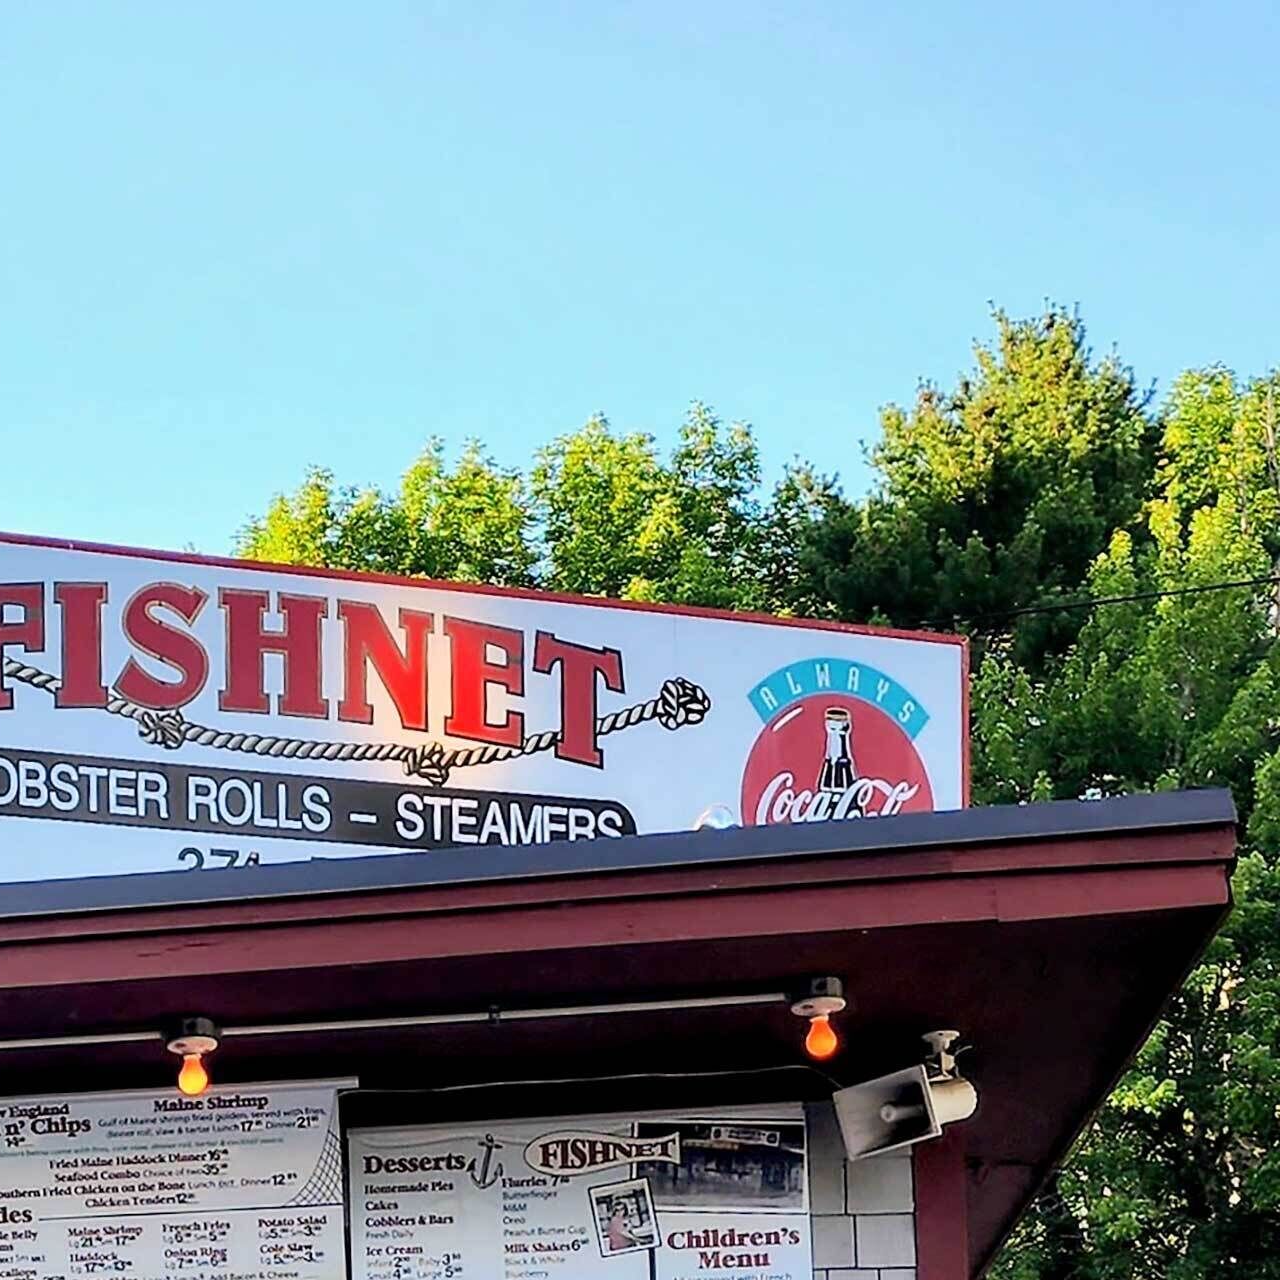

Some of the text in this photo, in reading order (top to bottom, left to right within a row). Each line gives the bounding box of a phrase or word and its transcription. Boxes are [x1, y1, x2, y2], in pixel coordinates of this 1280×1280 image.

[759, 662, 916, 723] ALWAYS
[187, 774, 332, 833] ROLLS
[7, 1103, 70, 1119] England
[153, 1094, 269, 1114] Maine Shrimp
[29, 1116, 92, 1138] Chips
[362, 1152, 467, 1175] Desserts
[539, 1138, 677, 1169] FISHNET
[364, 1181, 454, 1195] Homemade Pies
[365, 1201, 399, 1212] Cakes
[365, 1216, 416, 1228] Cobblers
[429, 1214, 454, 1225] Bars
[666, 1228, 801, 1251] Children's
[366, 1244, 424, 1256] Ice Cream
[698, 1251, 771, 1270] Menu
